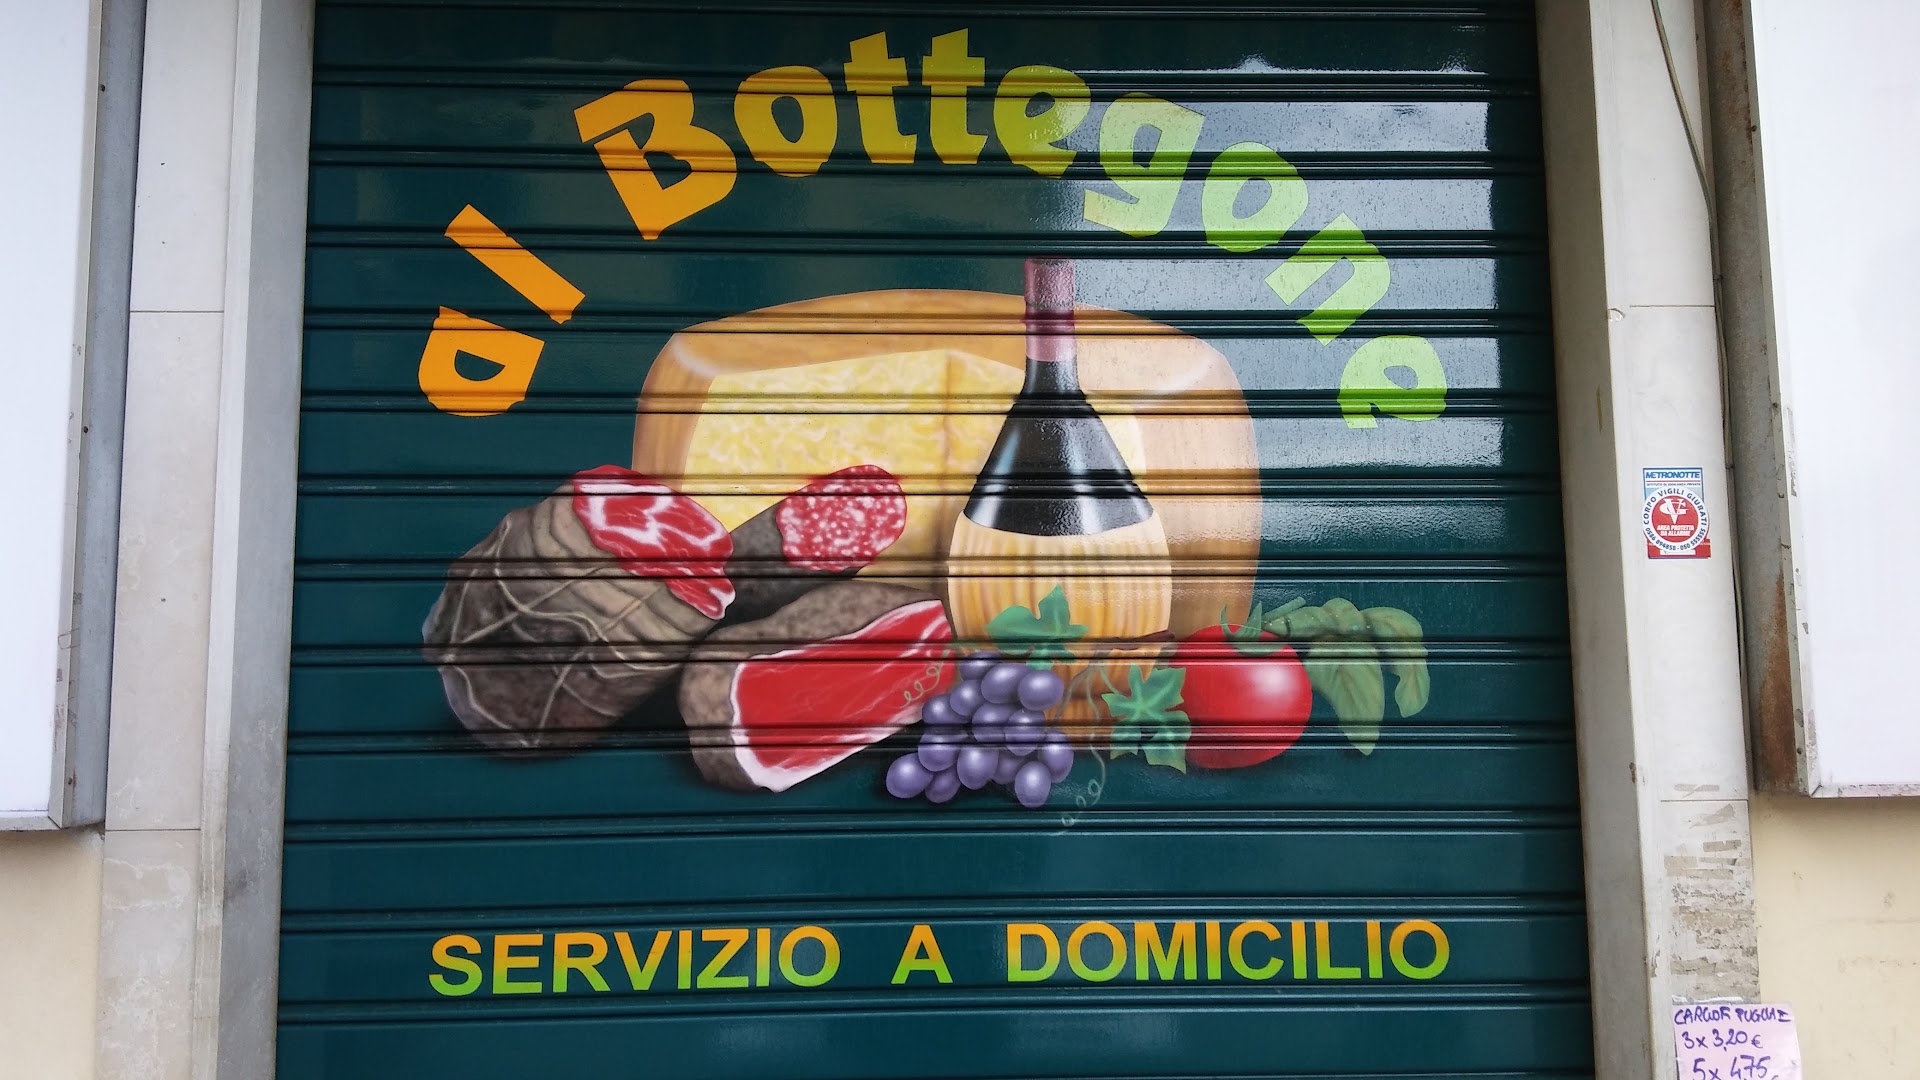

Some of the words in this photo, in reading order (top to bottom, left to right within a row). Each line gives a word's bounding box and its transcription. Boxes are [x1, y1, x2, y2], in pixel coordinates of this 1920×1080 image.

[574, 28, 1448, 428] Bottegone
[1643, 496, 1656, 525] CORPO
[1657, 488, 1685, 497] VIGILI
[1686, 493, 1707, 526] GIURATI
[429, 925, 841, 997] SERVIZIO
[891, 924, 953, 985] A
[1007, 919, 1450, 983] DOMICILIO
